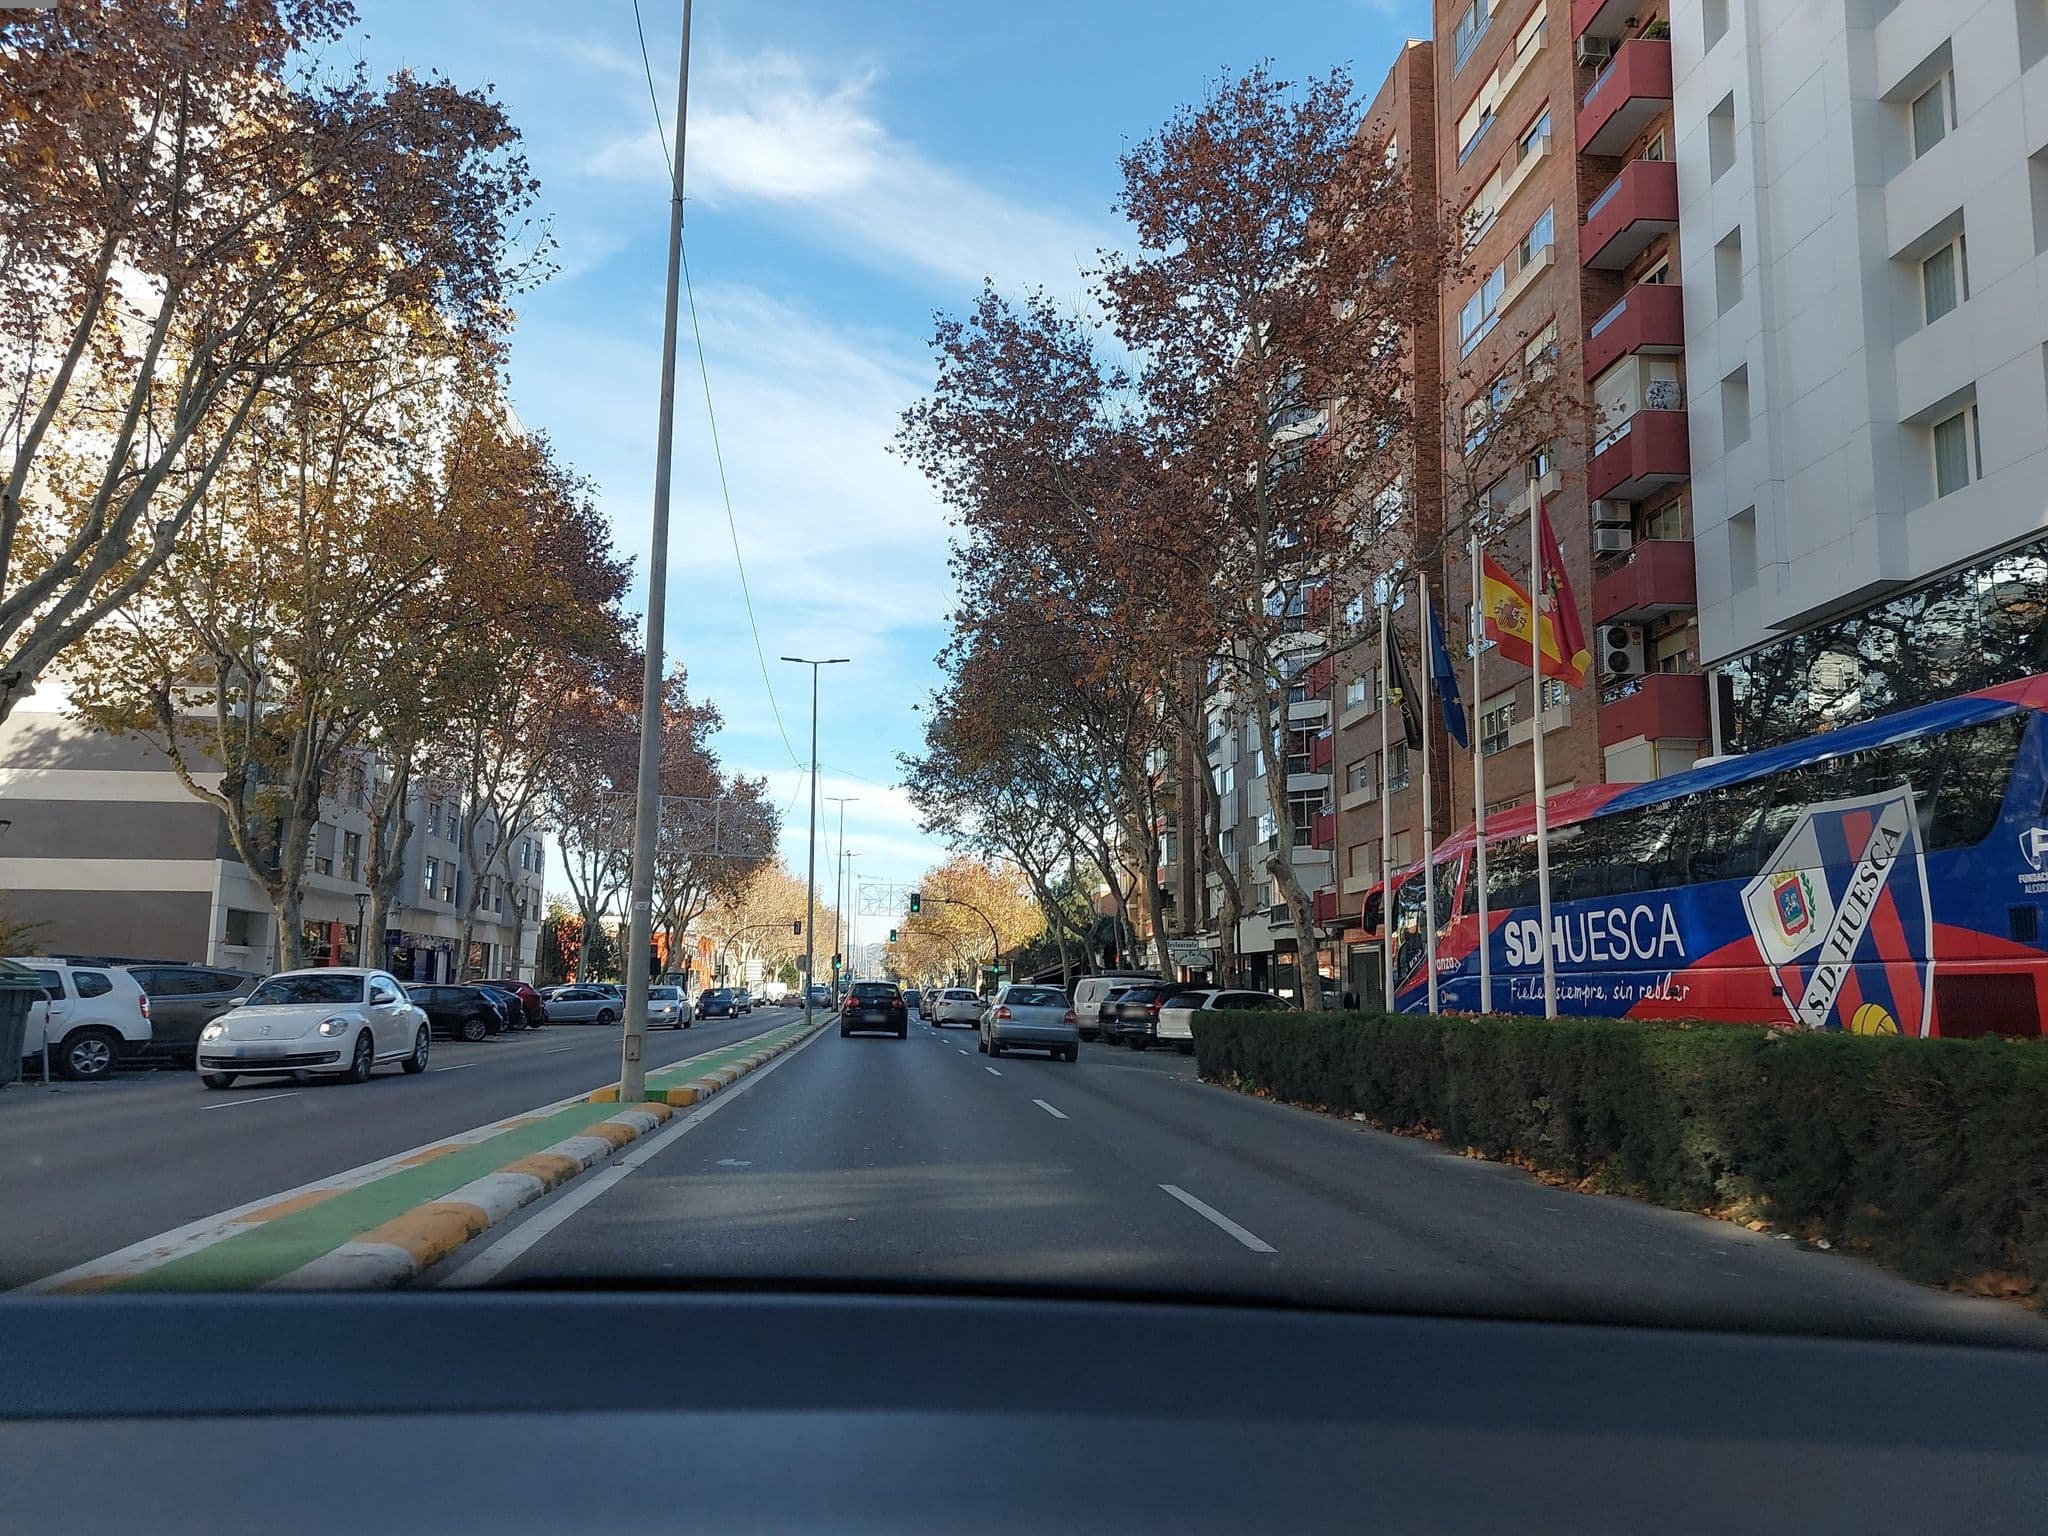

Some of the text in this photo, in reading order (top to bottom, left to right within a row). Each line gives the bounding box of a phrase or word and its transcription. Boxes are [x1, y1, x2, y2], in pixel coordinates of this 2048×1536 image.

[1830, 826, 1901, 960] HUESCA
[1510, 976, 1546, 1001] Fiele
[1613, 979, 1633, 1001] sin
